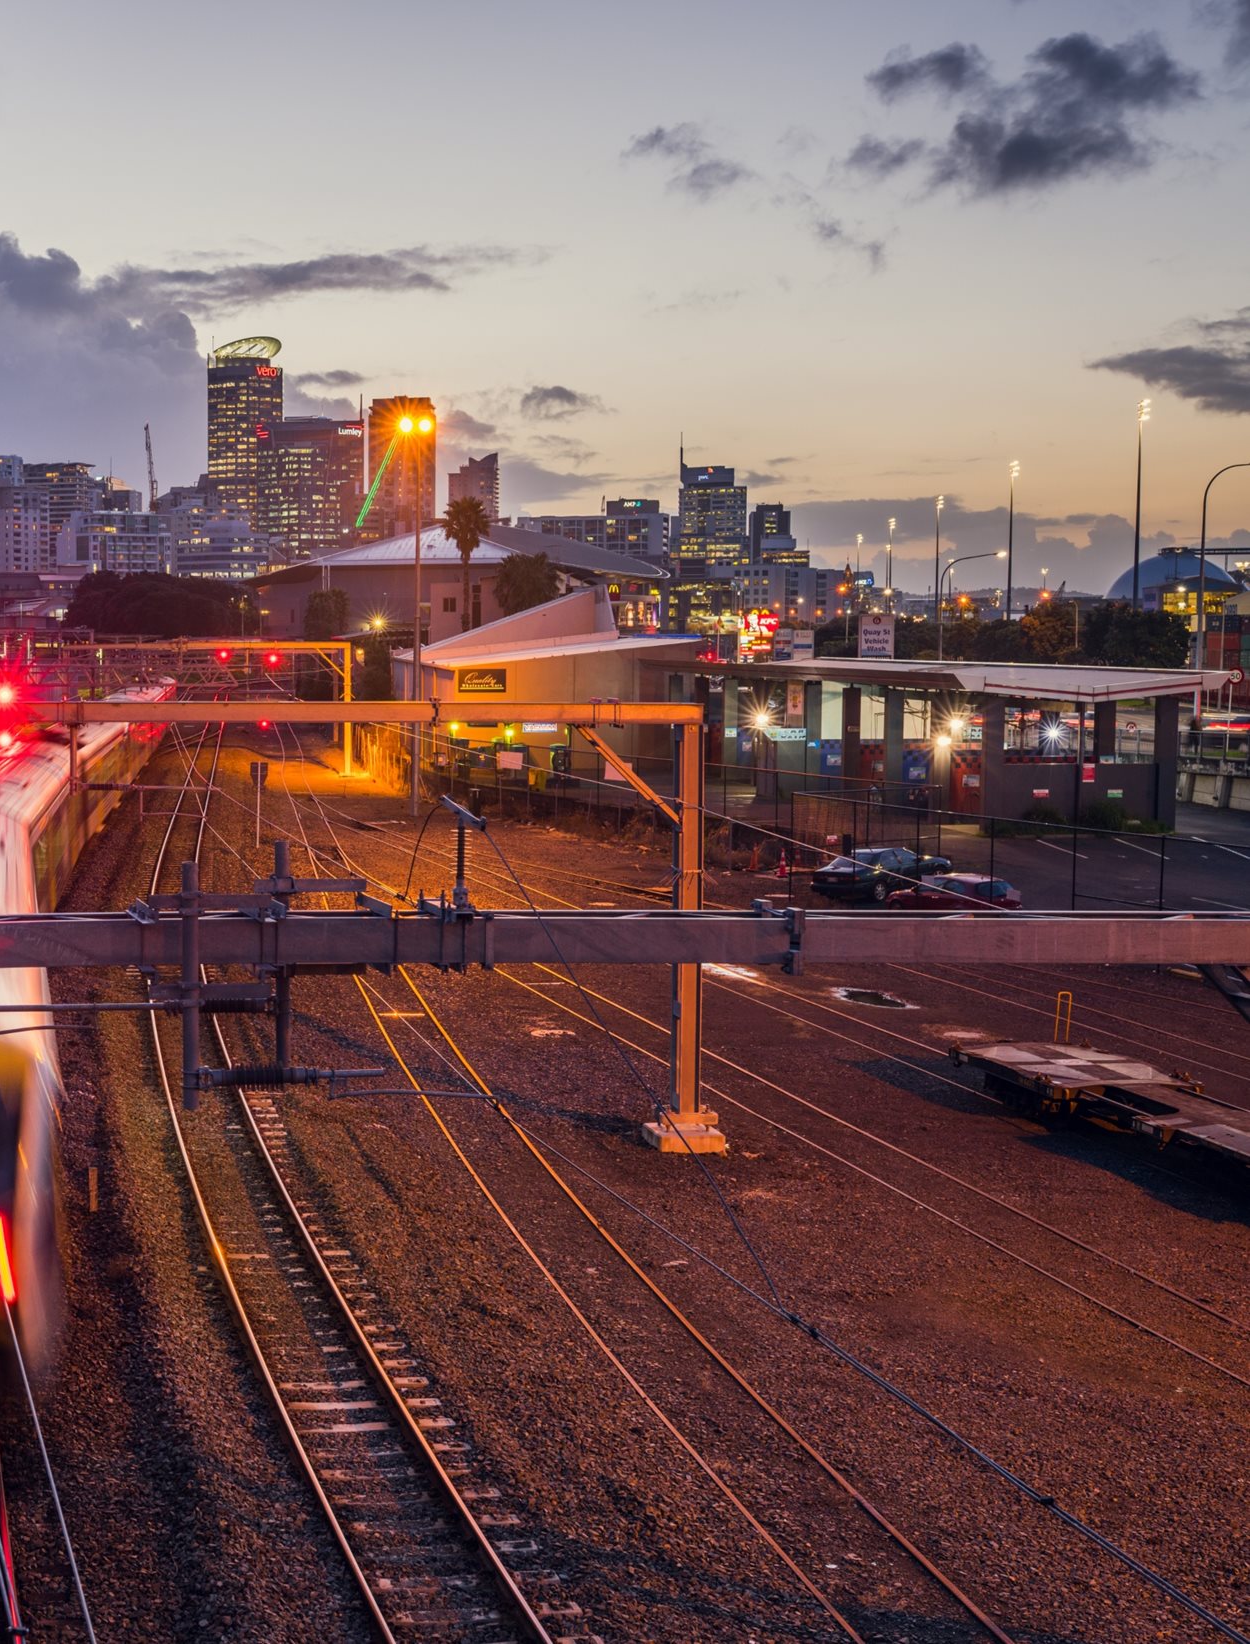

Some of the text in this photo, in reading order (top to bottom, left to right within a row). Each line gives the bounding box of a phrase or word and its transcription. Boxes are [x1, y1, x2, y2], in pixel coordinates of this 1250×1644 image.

[338, 427, 362, 438] Lumley
[464, 671, 497, 687] Quality
[1231, 672, 1241, 680] 50
